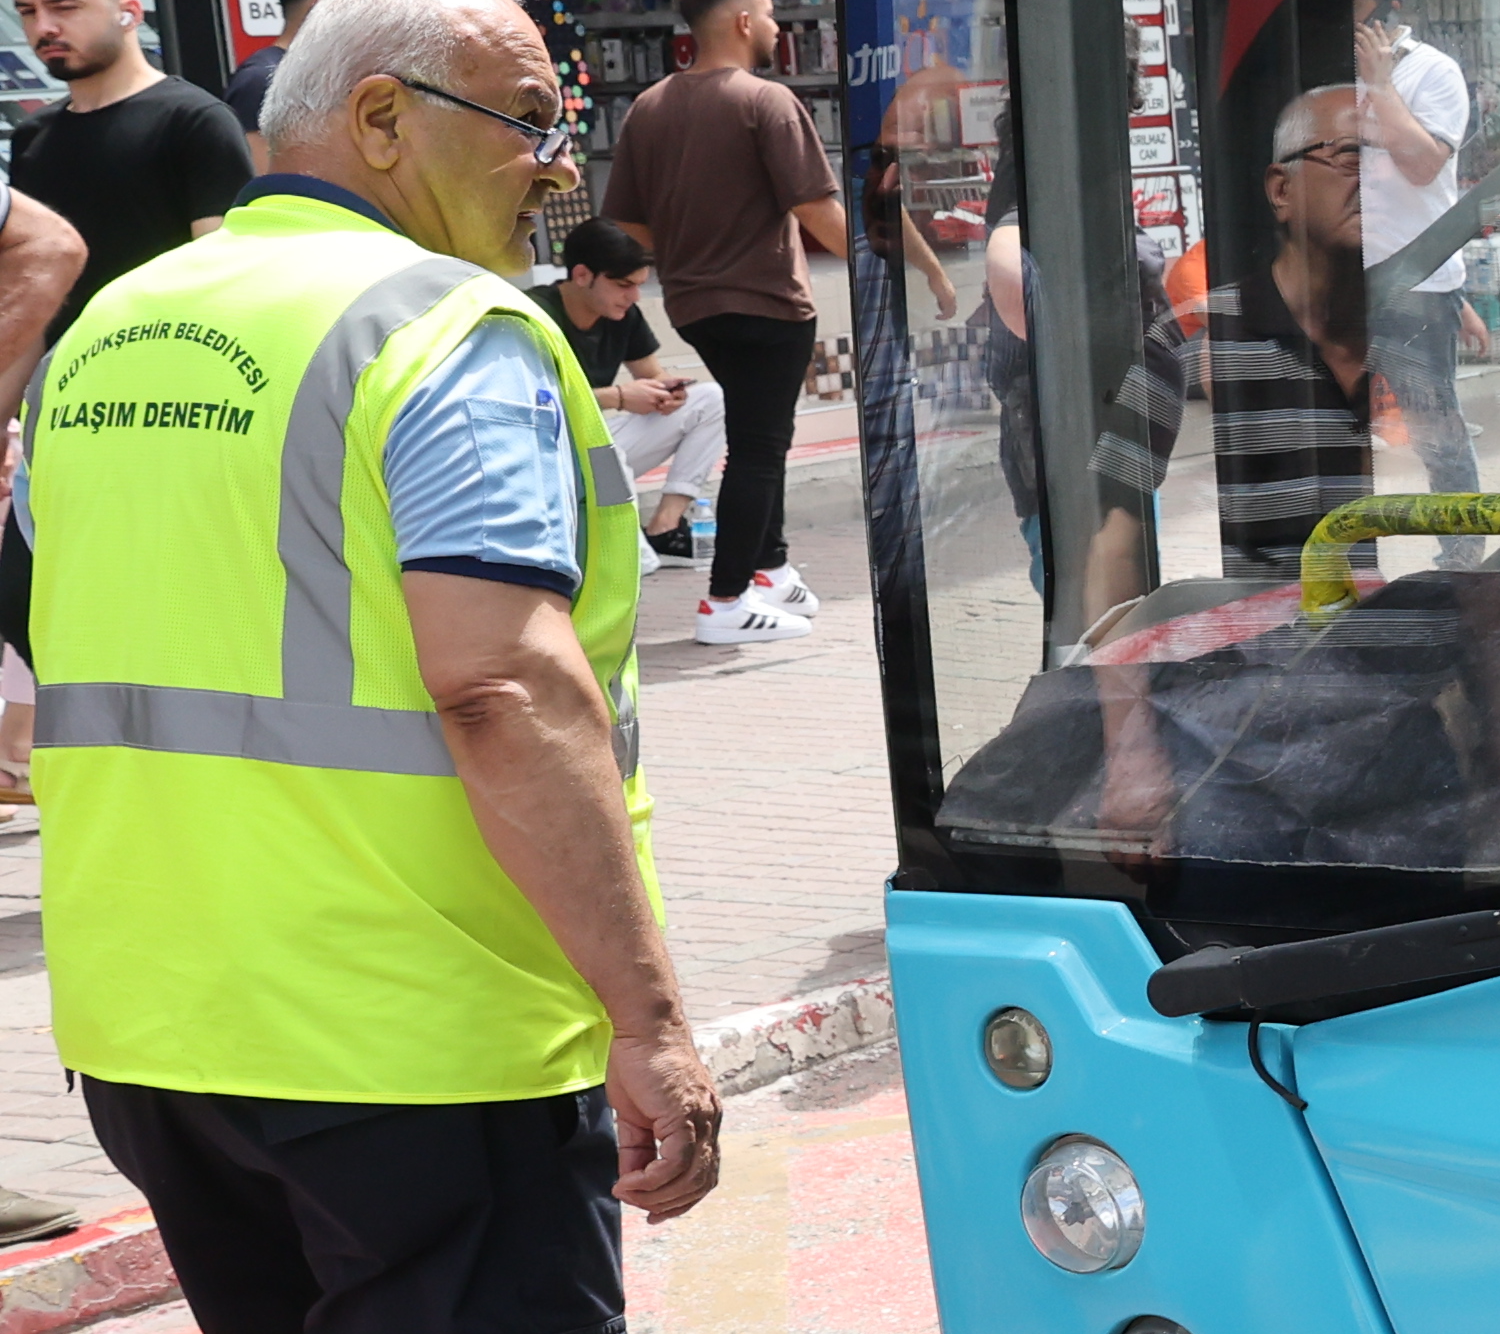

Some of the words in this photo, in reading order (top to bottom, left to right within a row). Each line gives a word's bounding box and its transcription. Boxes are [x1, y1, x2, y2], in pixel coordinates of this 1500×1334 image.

[57, 319, 172, 393] BÜYÜKŞEHİR
[174, 322, 270, 394] BELEDİYESİ
[50, 401, 138, 434] ULAŞIM
[142, 398, 255, 435] DENETİM
